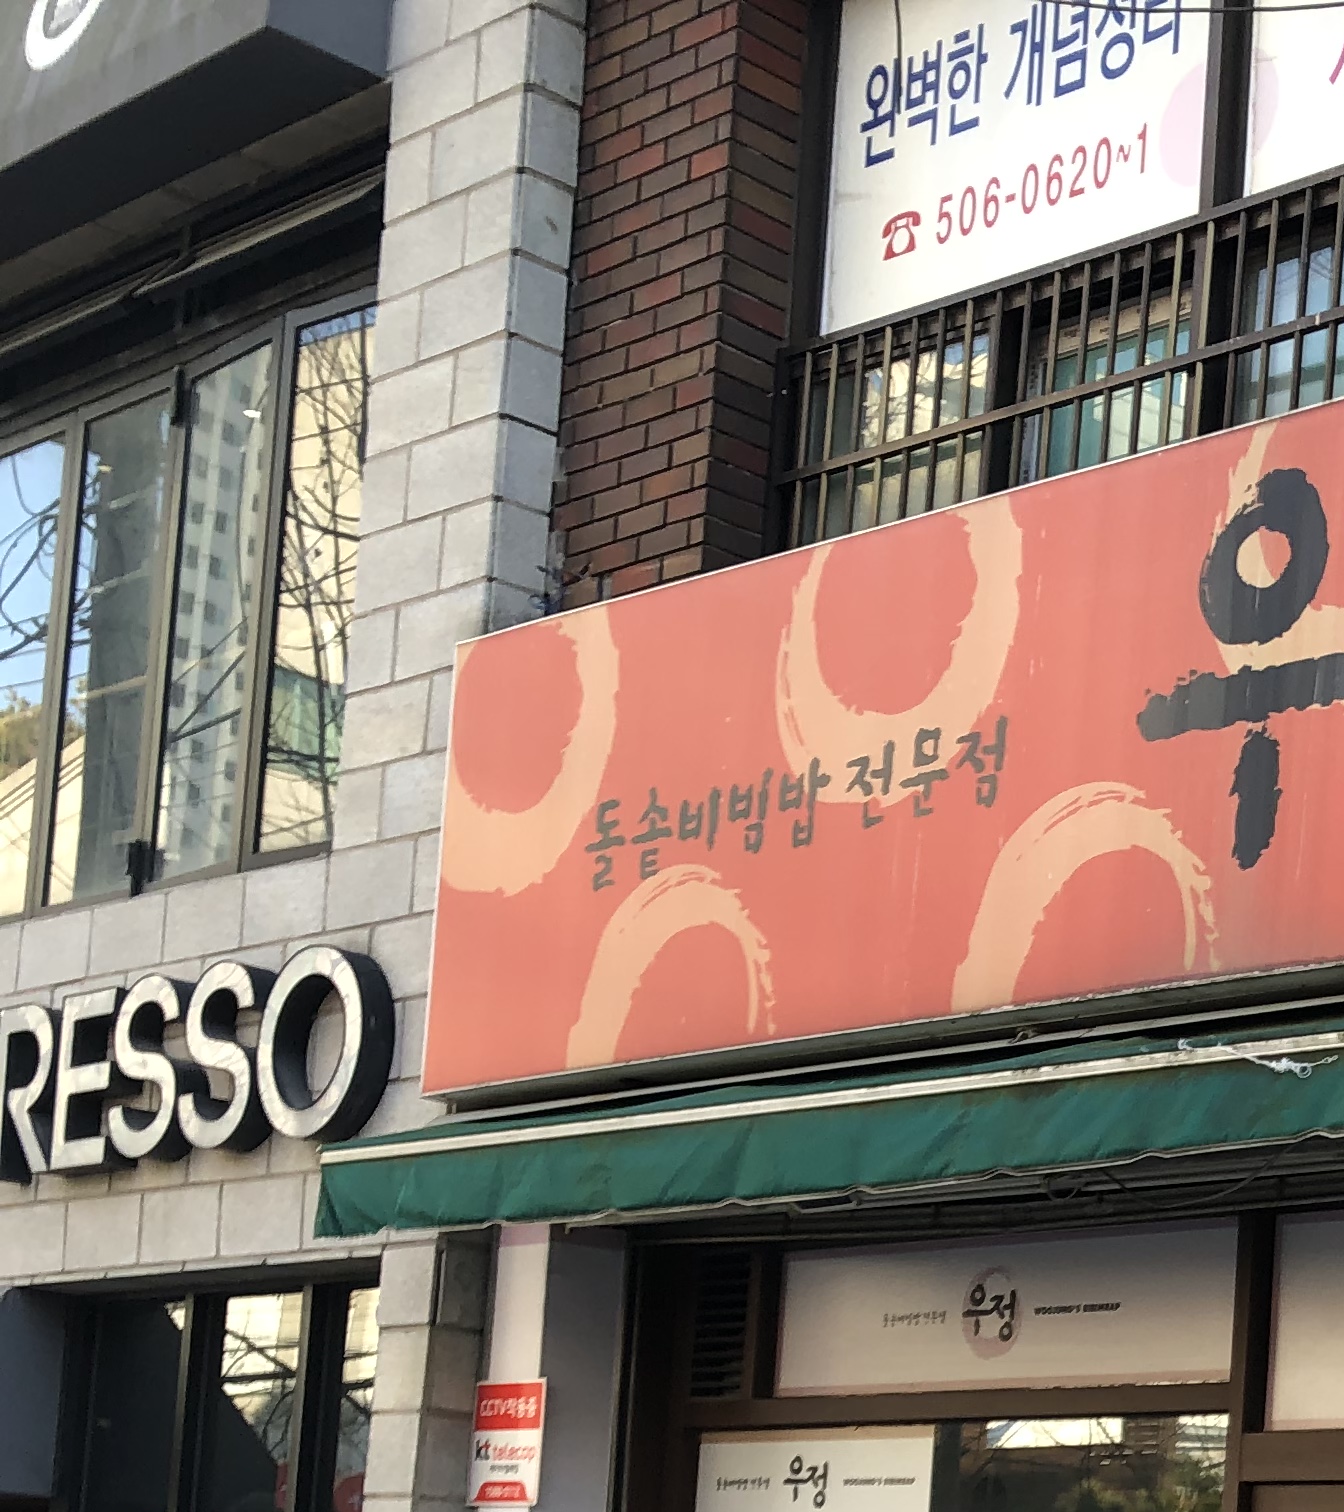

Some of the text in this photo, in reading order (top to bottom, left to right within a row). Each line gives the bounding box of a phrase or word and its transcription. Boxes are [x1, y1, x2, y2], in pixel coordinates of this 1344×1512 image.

[860, 0, 1180, 168] 완벽한 개념정리
[586, 717, 1011, 890] 돌솥비빔밥 전문점
[0, 944, 368, 1174] RESSO
[962, 1283, 1017, 1342] 우정
[783, 1454, 829, 1509] 우정
